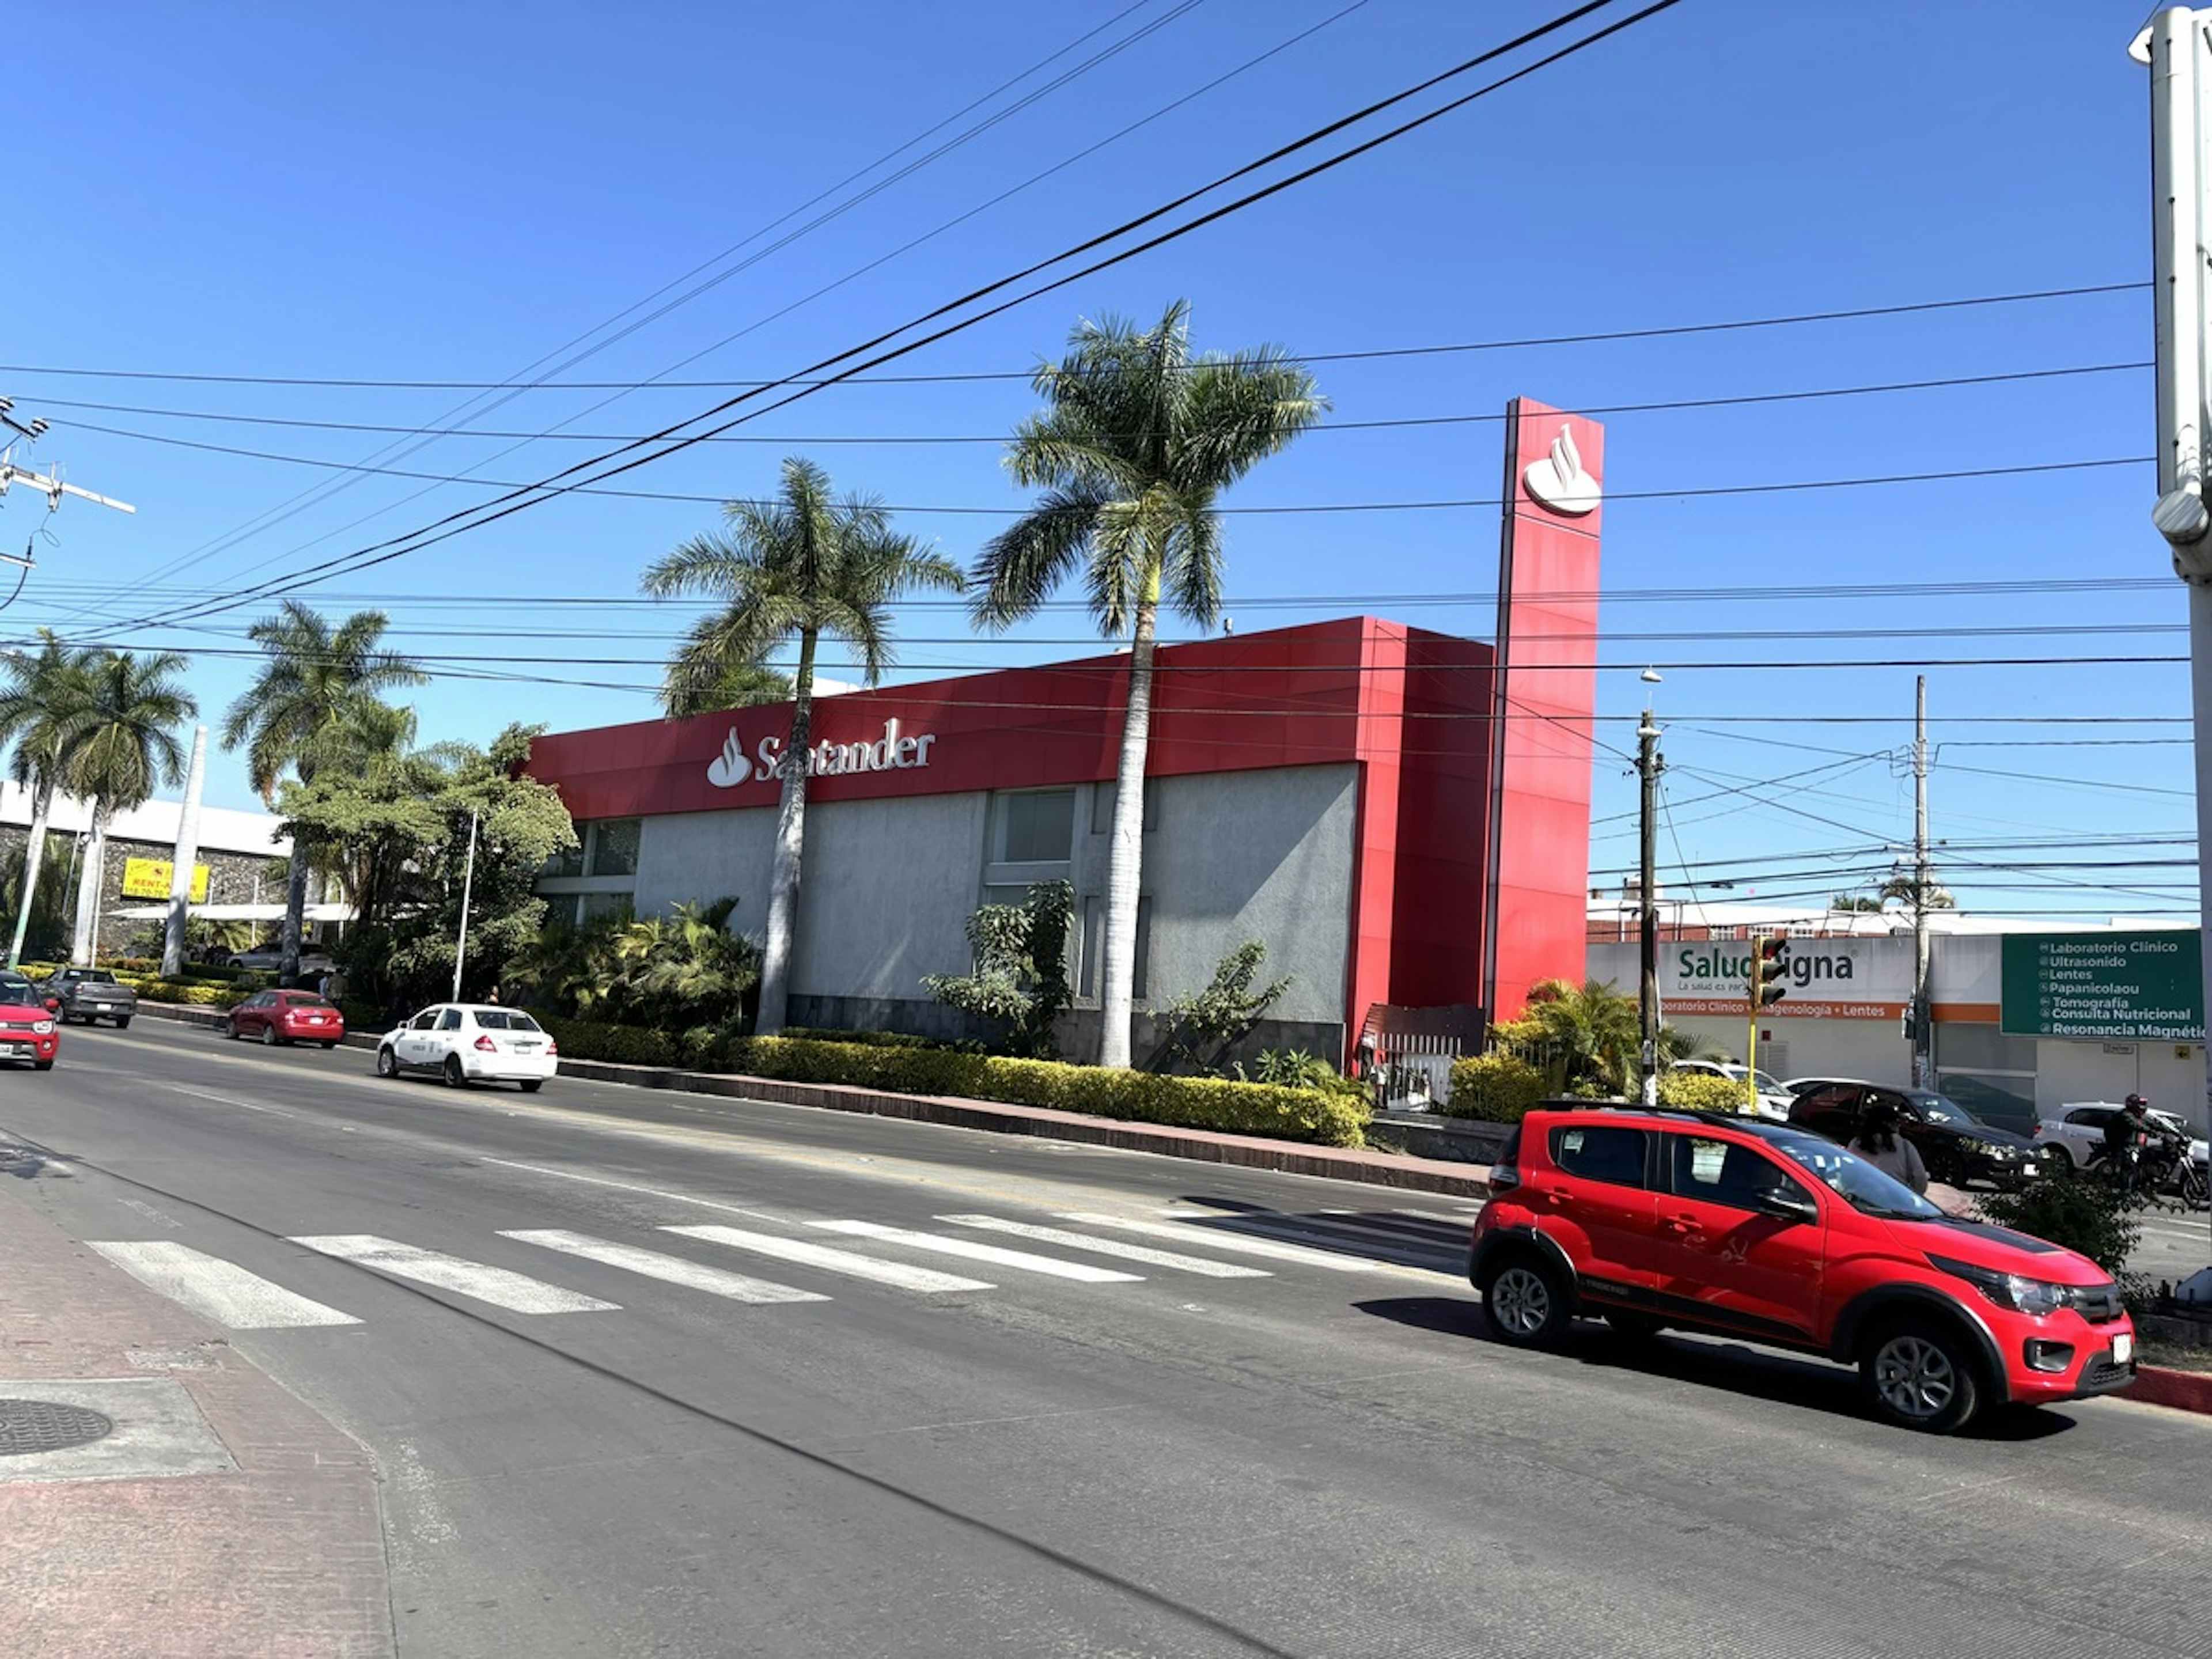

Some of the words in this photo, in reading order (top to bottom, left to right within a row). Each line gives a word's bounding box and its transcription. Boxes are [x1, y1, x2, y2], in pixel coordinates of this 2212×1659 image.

[2050, 941, 2127, 954] Laboratorio
[1777, 945, 1853, 987] igna
[2050, 955, 2127, 967] Ultrasonido
[2049, 969, 2093, 980] Lentes
[1691, 982, 1713, 991] salud
[1714, 983, 1726, 991] es
[2049, 982, 2140, 996] Papanicolaou
[1842, 1004, 1885, 1017] Lentes
[2051, 1008, 2111, 1020] Consulta
[2113, 1007, 2191, 1020] Nutricional
[2052, 1022, 2136, 1036] Resonancia
